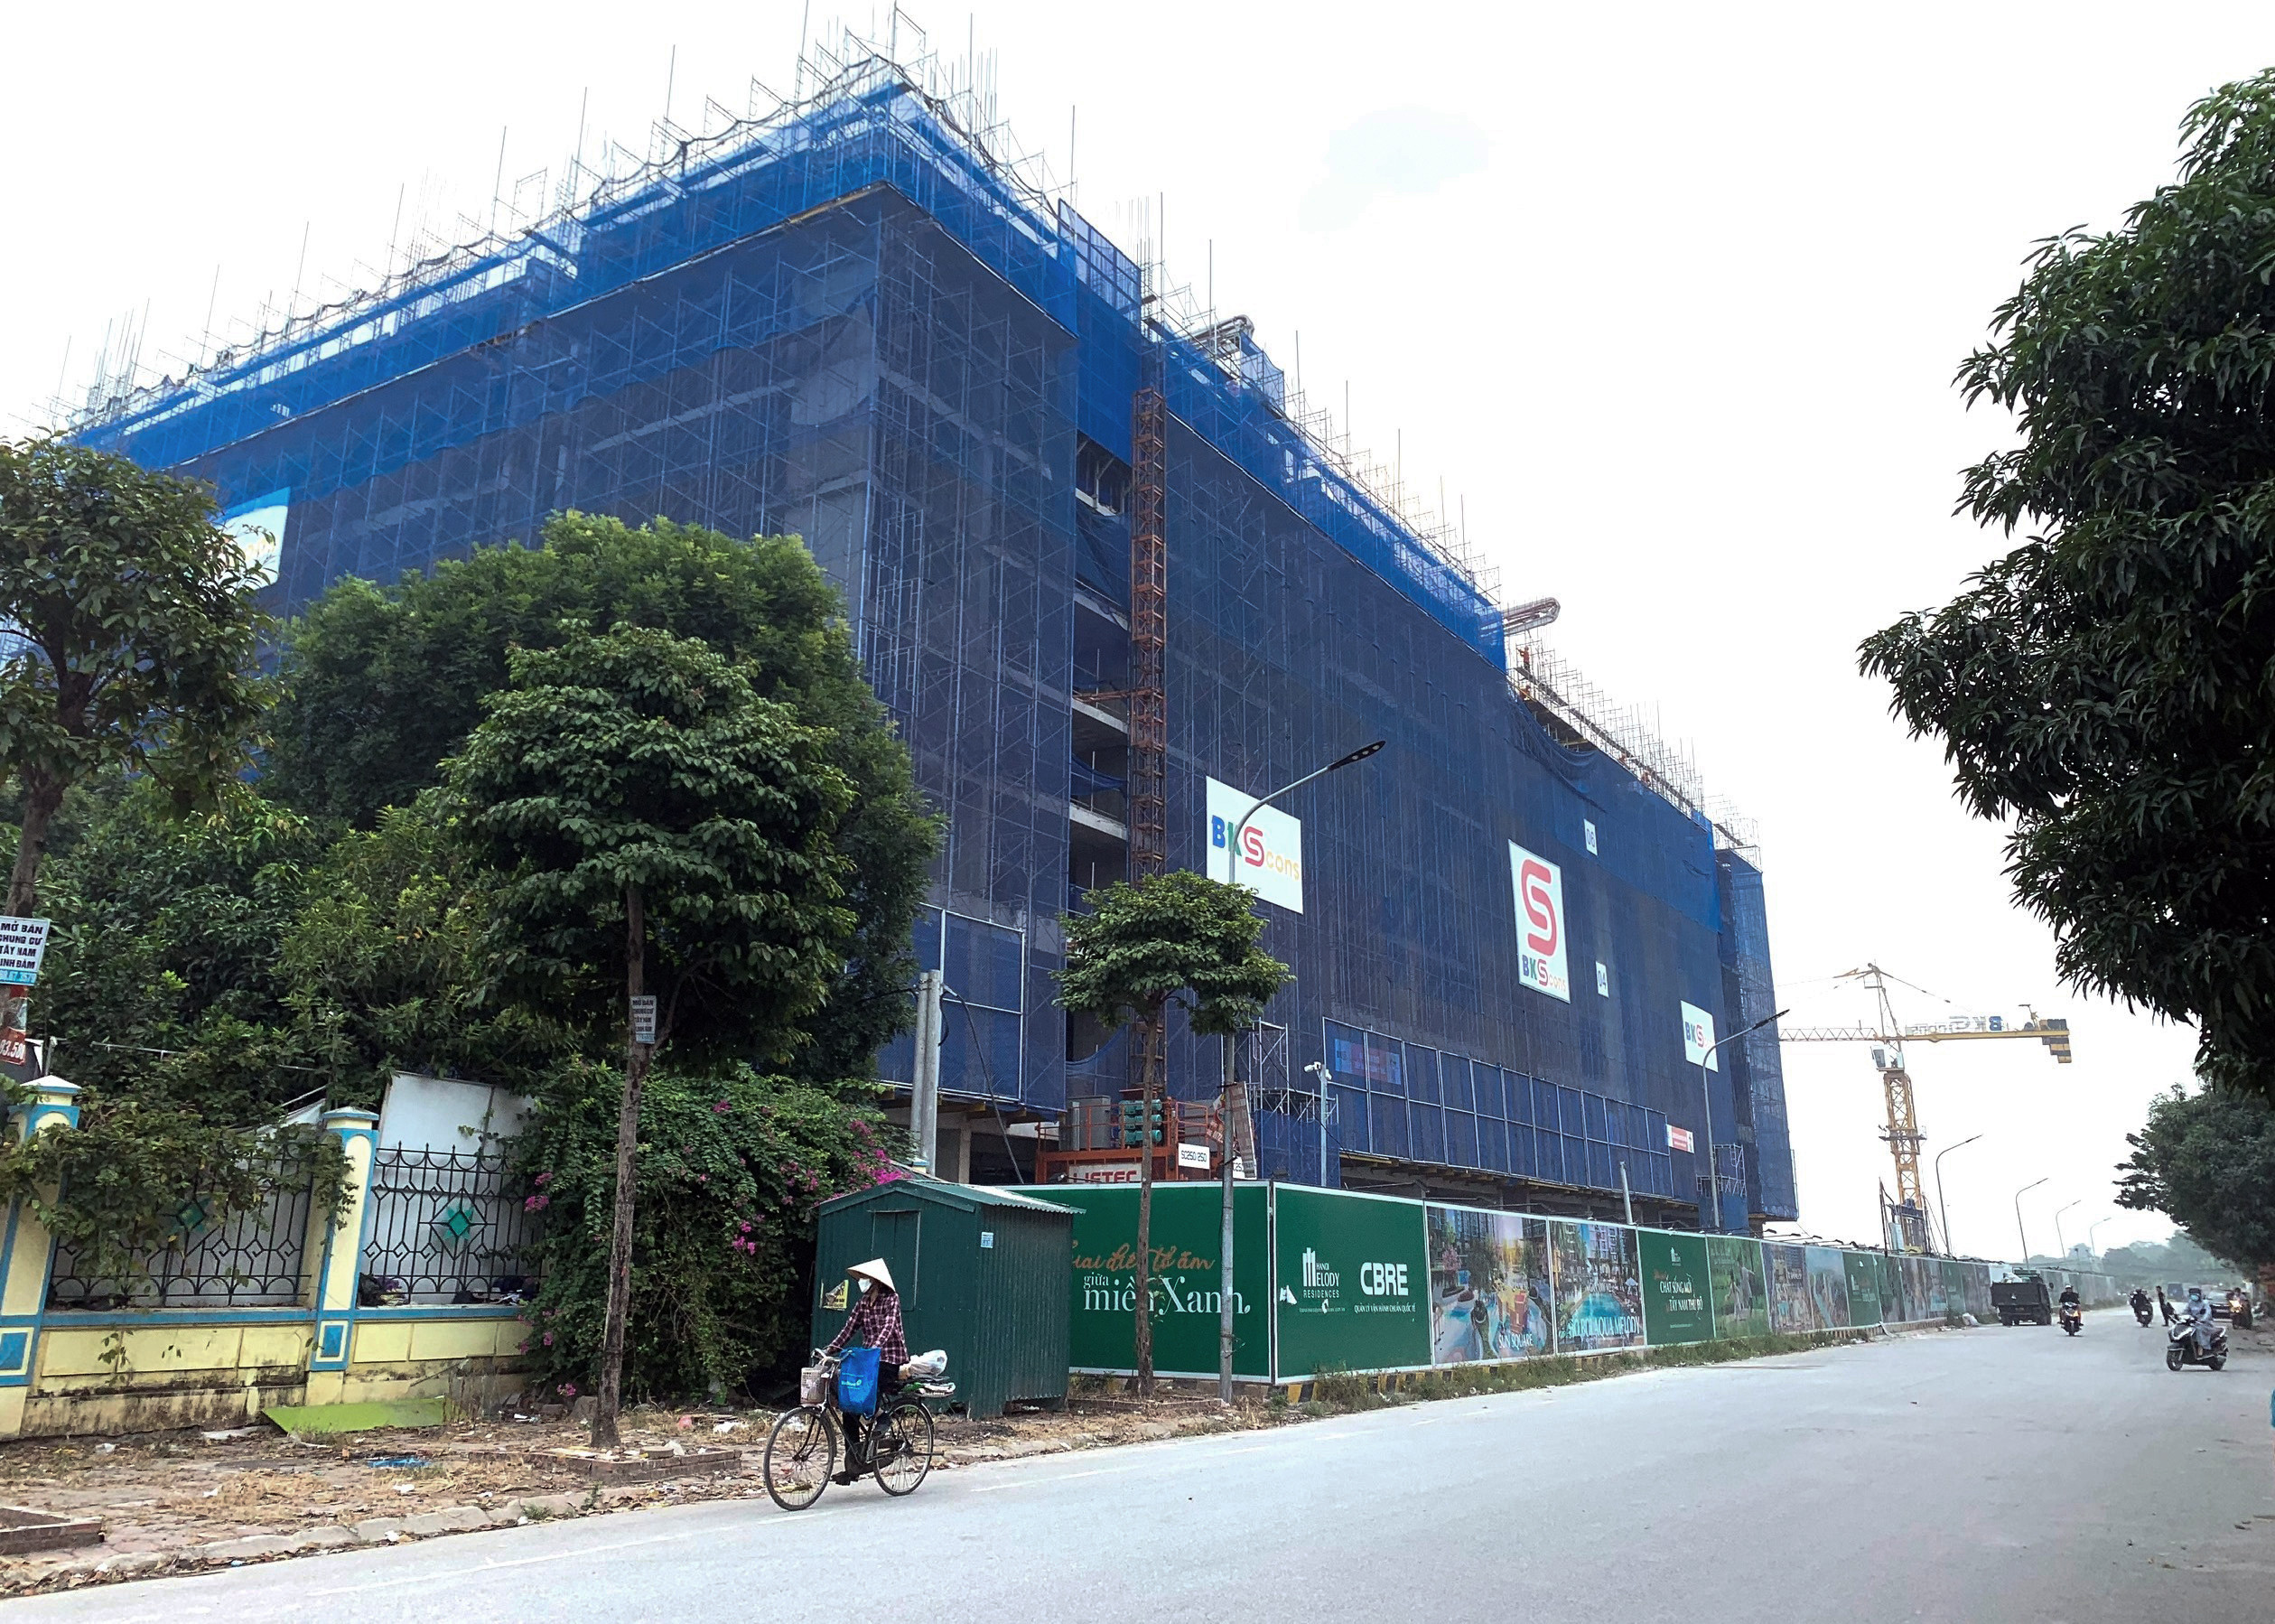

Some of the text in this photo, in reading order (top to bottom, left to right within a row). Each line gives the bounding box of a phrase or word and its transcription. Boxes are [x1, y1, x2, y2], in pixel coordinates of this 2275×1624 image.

[17, 947, 36, 957] NAM
[0, 958, 15, 967] INH
[1360, 1262, 1409, 1296] CBRE
[1303, 1289, 1339, 1299] RESIDENCES
